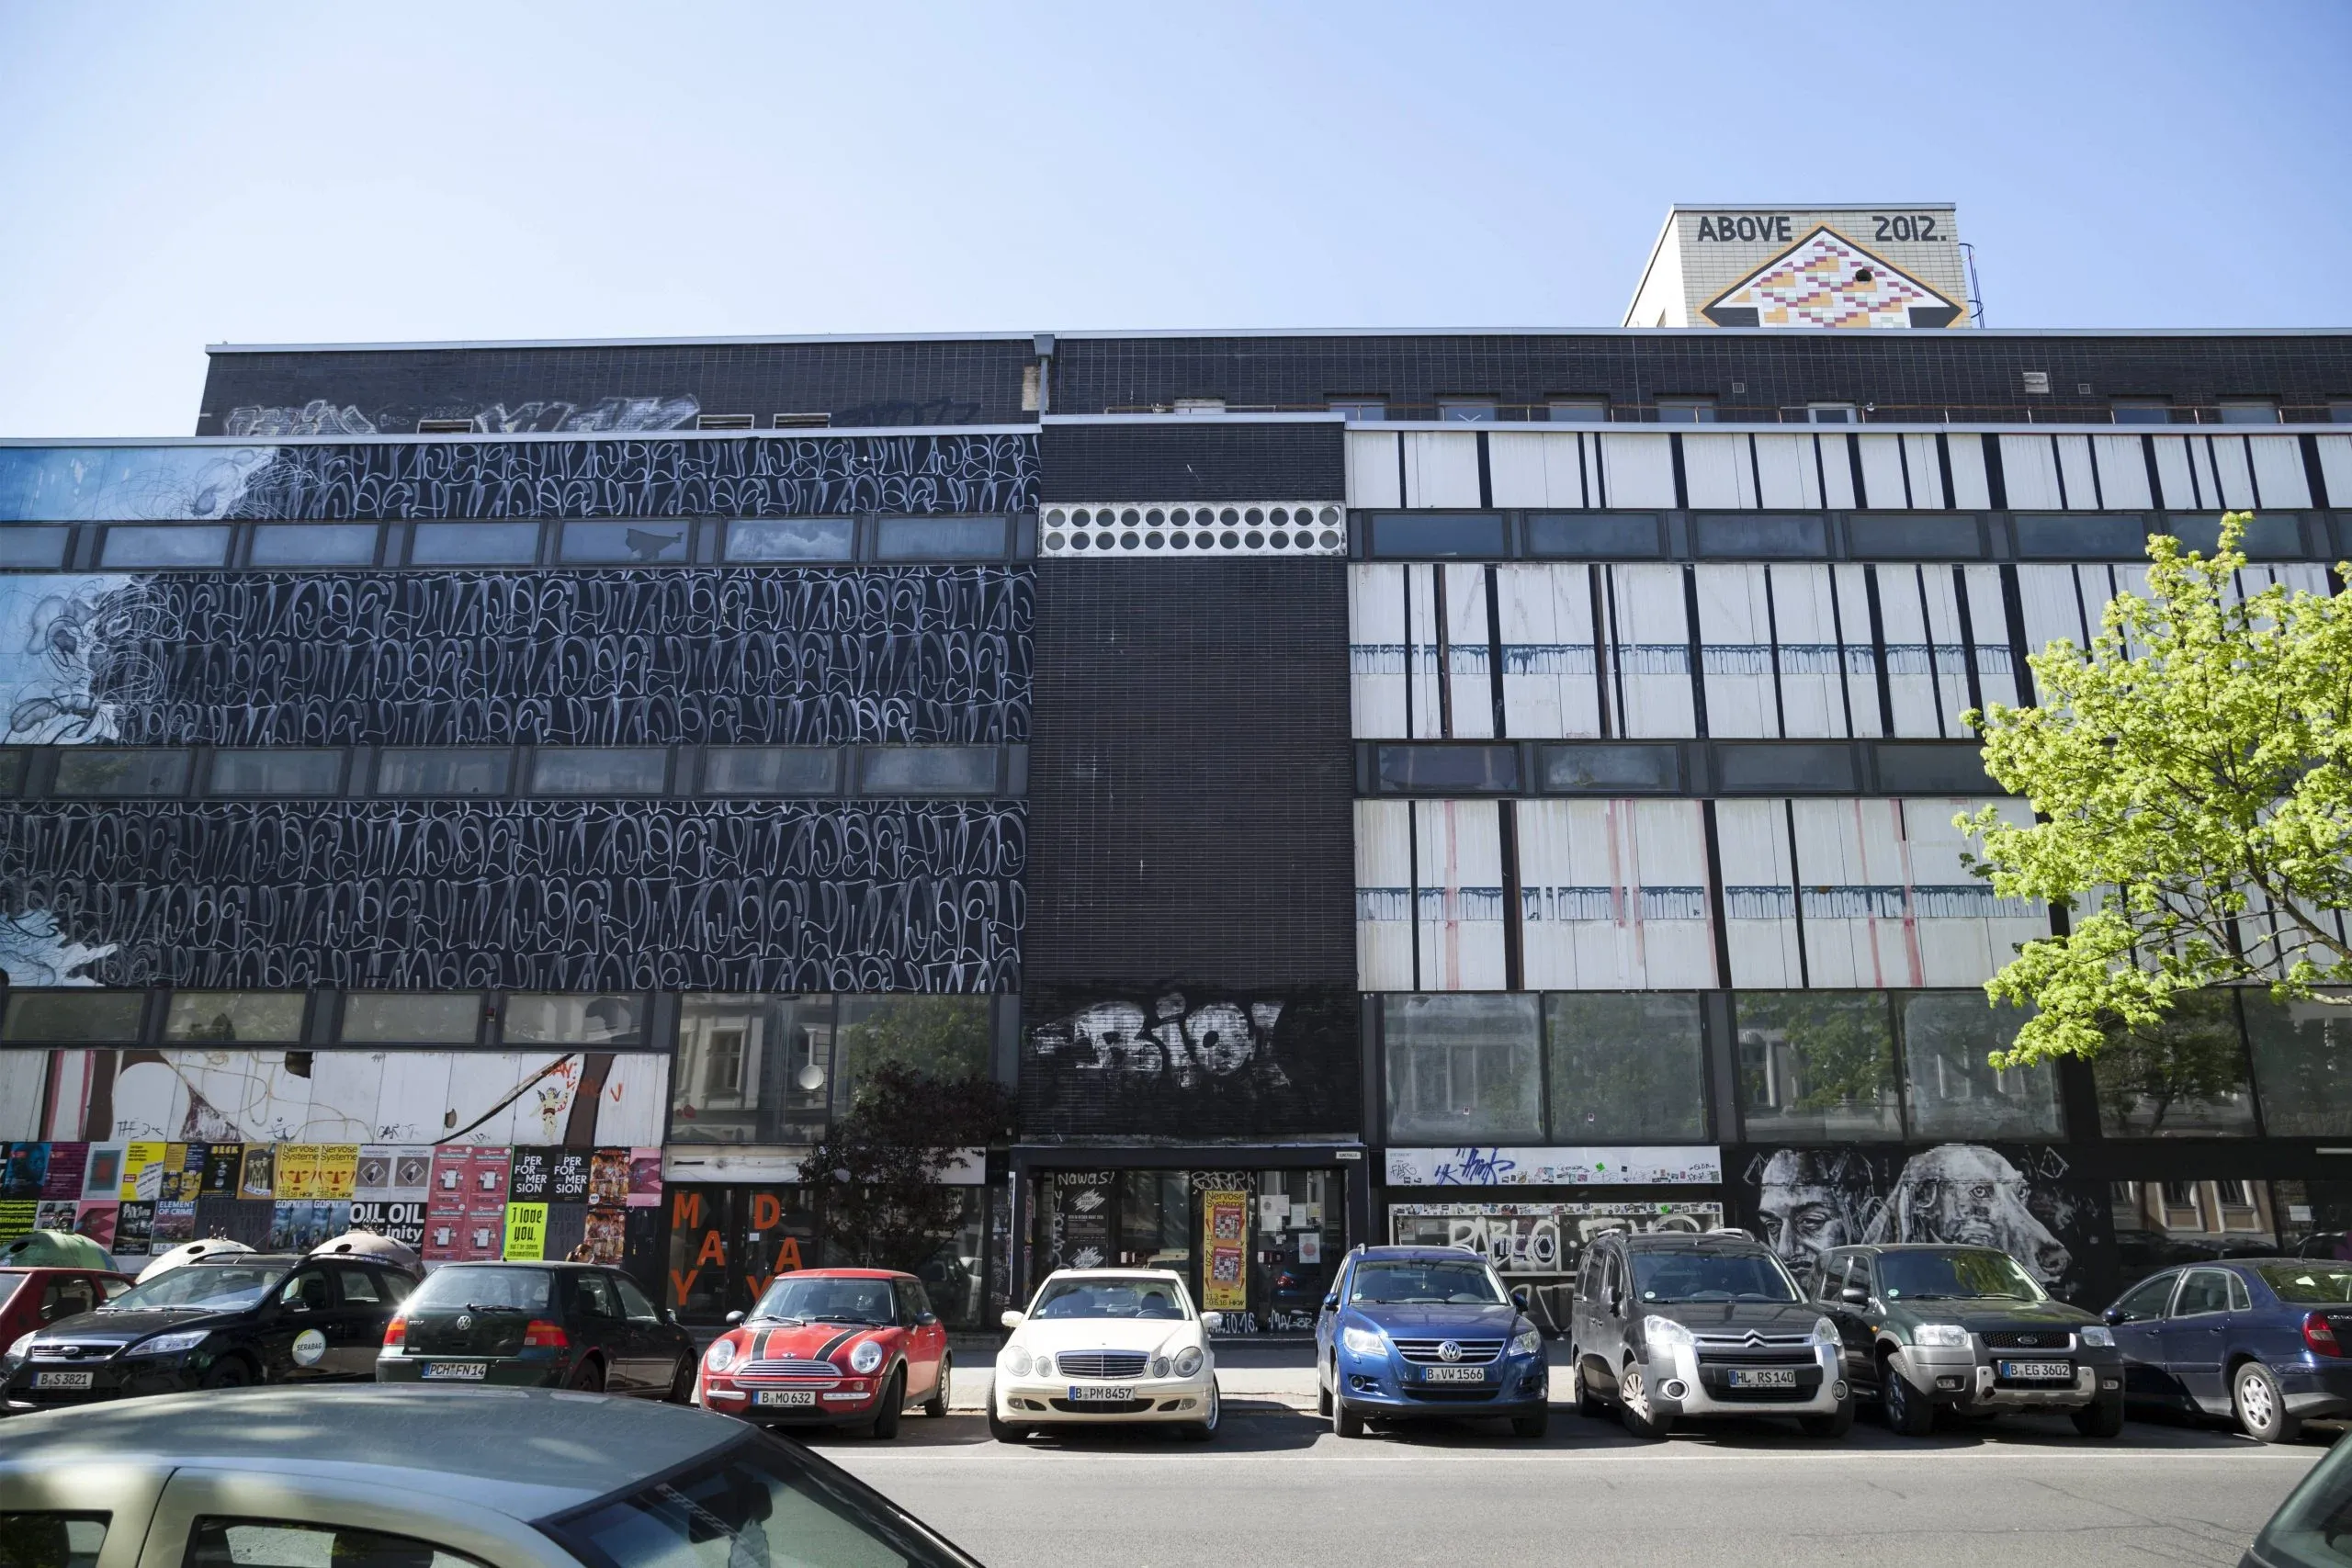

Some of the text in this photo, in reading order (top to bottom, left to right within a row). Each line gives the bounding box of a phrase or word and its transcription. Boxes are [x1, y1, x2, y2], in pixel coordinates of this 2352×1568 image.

[1697, 215, 1948, 243] ABOVE 2012.
[283, 1145, 319, 1153] Nervöse
[322, 1145, 358, 1153] Nervöse
[282, 1153, 319, 1162] Systeme
[320, 1153, 358, 1162] Systeme
[524, 1156, 542, 1166] PER
[563, 1156, 582, 1166] PER
[514, 1165, 536, 1175] FOR
[554, 1166, 575, 1175] FOR
[525, 1175, 548, 1184] MER
[565, 1175, 587, 1184] MER
[515, 1183, 542, 1193] SION
[556, 1184, 582, 1193] SION
[1205, 1191, 1245, 1201] Nervöse
[349, 1203, 386, 1224] OIL
[388, 1203, 424, 1224] OIL
[519, 1207, 543, 1224] love
[514, 1226, 537, 1243] you,
[429, 1364, 485, 1375] PCH FN 14
[1427, 1369, 1483, 1380] B VW 1566
[2010, 1364, 2069, 1375] B EG 3602
[40, 1373, 87, 1384] B S 3821
[1736, 1372, 1793, 1383] HL RS 140
[762, 1393, 810, 1403] B MO 632
[1075, 1388, 1132, 1398] B PM 8457
